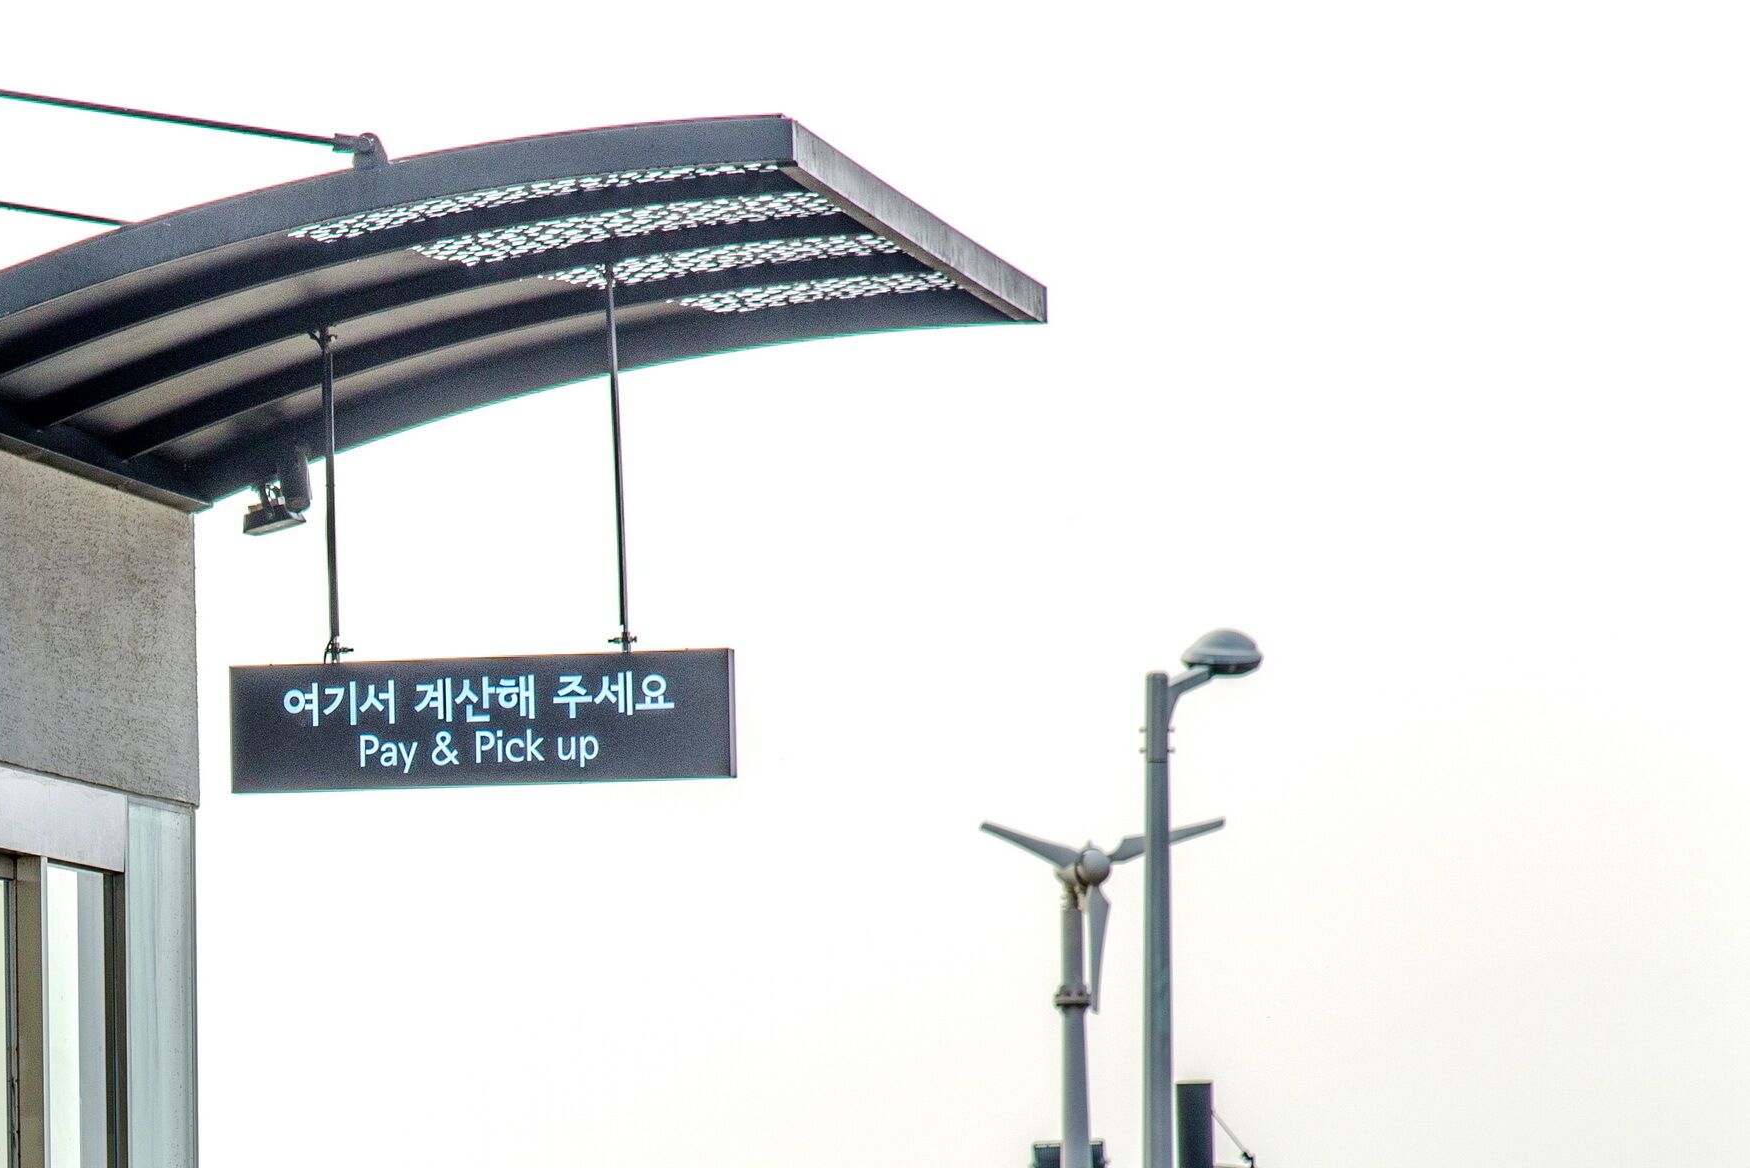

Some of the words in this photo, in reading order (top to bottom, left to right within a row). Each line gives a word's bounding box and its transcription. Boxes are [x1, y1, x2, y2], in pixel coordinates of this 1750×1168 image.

[283, 679, 396, 726] 여기서
[414, 675, 536, 723] 계산해
[553, 670, 675, 720] 주세요
[358, 733, 419, 774] Pay
[430, 729, 460, 767] &
[474, 728, 546, 764] Pick
[557, 730, 600, 768] up
